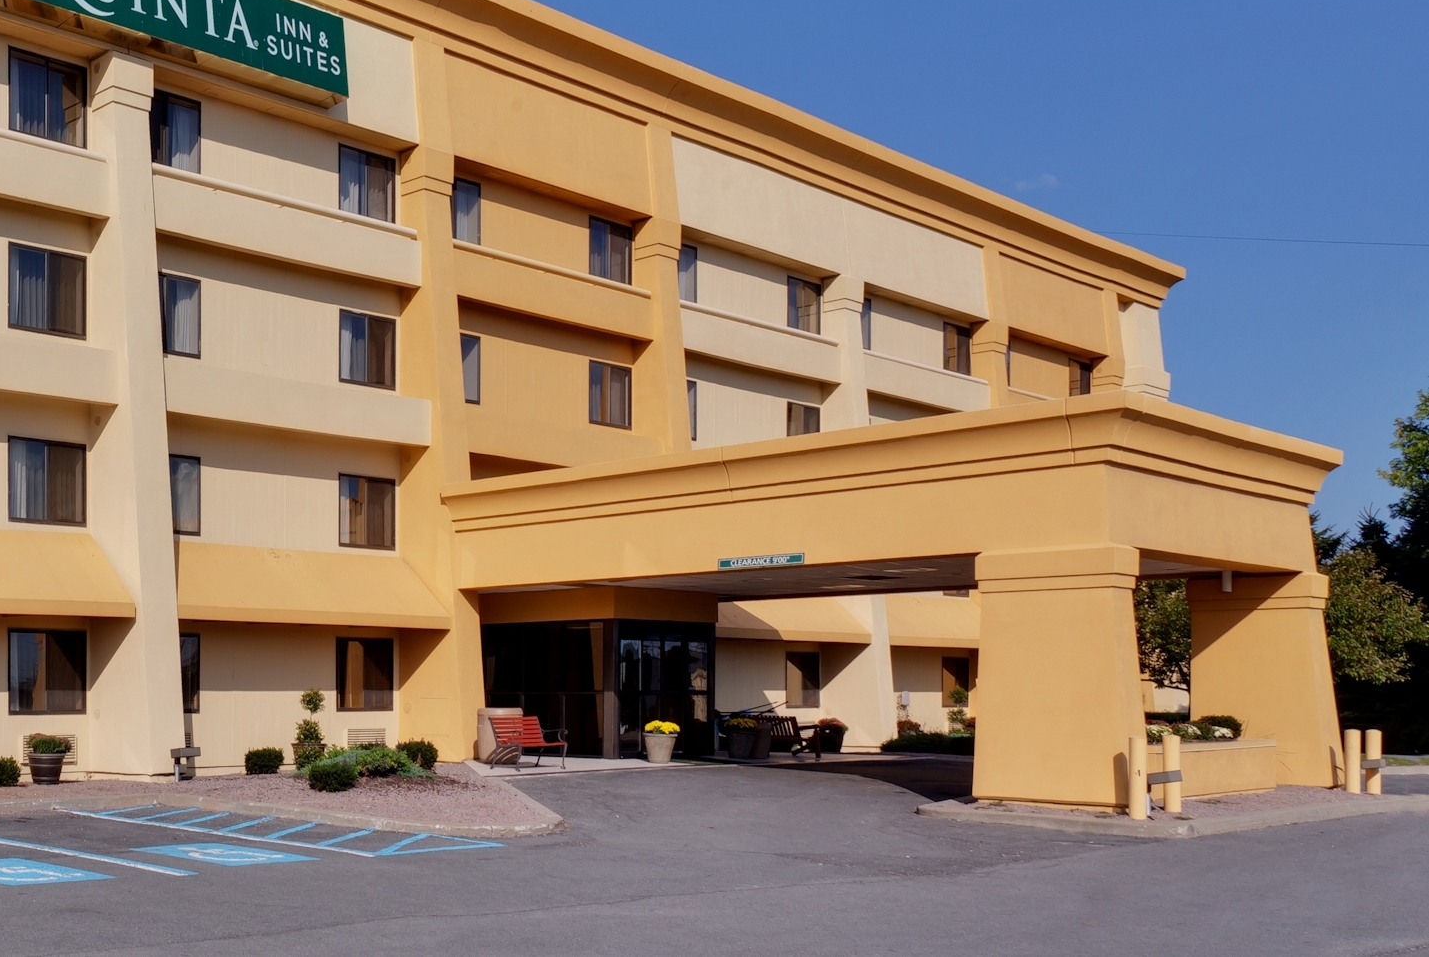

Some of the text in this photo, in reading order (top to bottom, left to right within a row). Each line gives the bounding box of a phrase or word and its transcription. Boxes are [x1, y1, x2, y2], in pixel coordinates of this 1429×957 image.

[276, 12, 329, 49] INN &
[267, 35, 341, 76] SUITES
[730, 557, 771, 567] CLEARANCE
